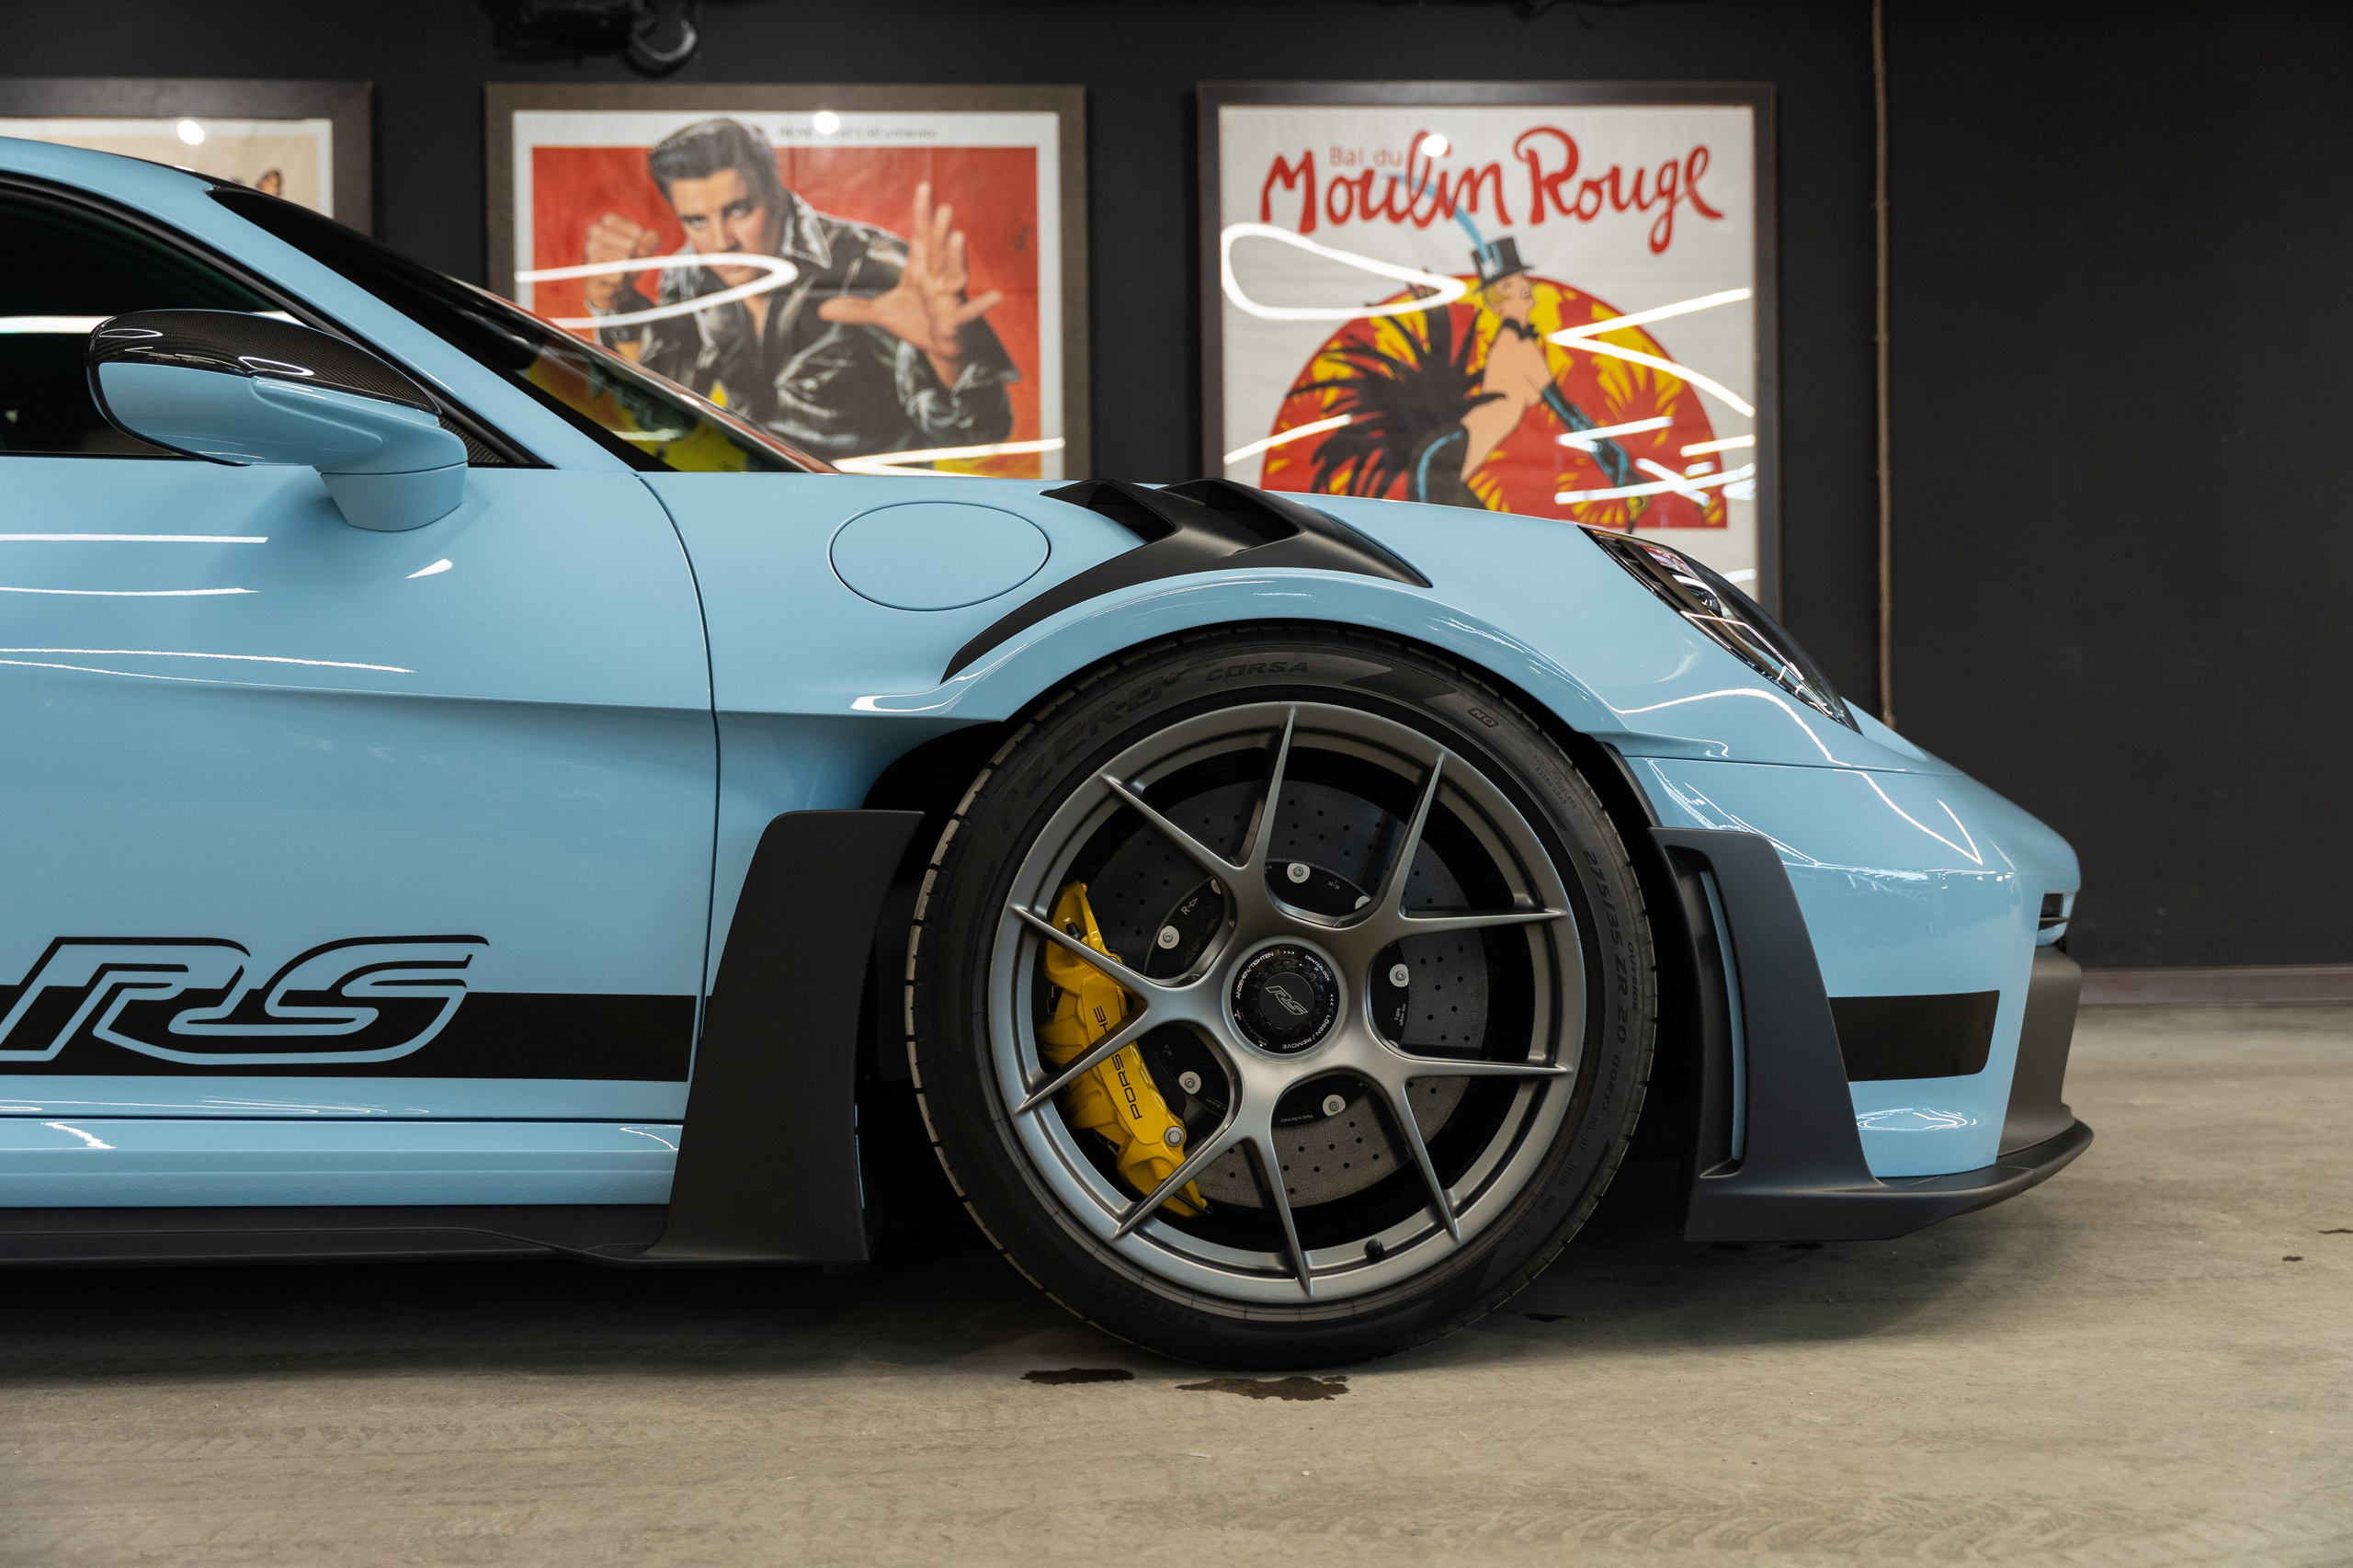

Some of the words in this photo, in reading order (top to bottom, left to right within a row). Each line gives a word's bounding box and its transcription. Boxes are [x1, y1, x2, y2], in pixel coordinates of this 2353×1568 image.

[1329, 145, 1365, 166] Bal
[1374, 143, 1404, 166] du
[1260, 130, 1514, 234] Moulin
[1514, 124, 1726, 256] Rouge
[1202, 660, 1308, 682] CORSA
[1532, 754, 1553, 776] RADIAL
[1552, 777, 1578, 810] TUBELESS
[1535, 767, 1554, 788] EXTRA
[1552, 788, 1568, 805] LOAD
[1181, 906, 1190, 915] R
[1581, 849, 1622, 948] 275/35
[1304, 954, 1331, 982] CENTERLOCK
[1614, 952, 1628, 995] ZR
[1627, 939, 1638, 1013] OUTSIDE
[0, 934, 490, 1066] RS
[1265, 985, 1308, 1016] RS
[1614, 1004, 1628, 1044] 20
[1093, 1005, 1142, 1120] PORSHE
[1093, 1274, 1211, 1335] IRELLI
